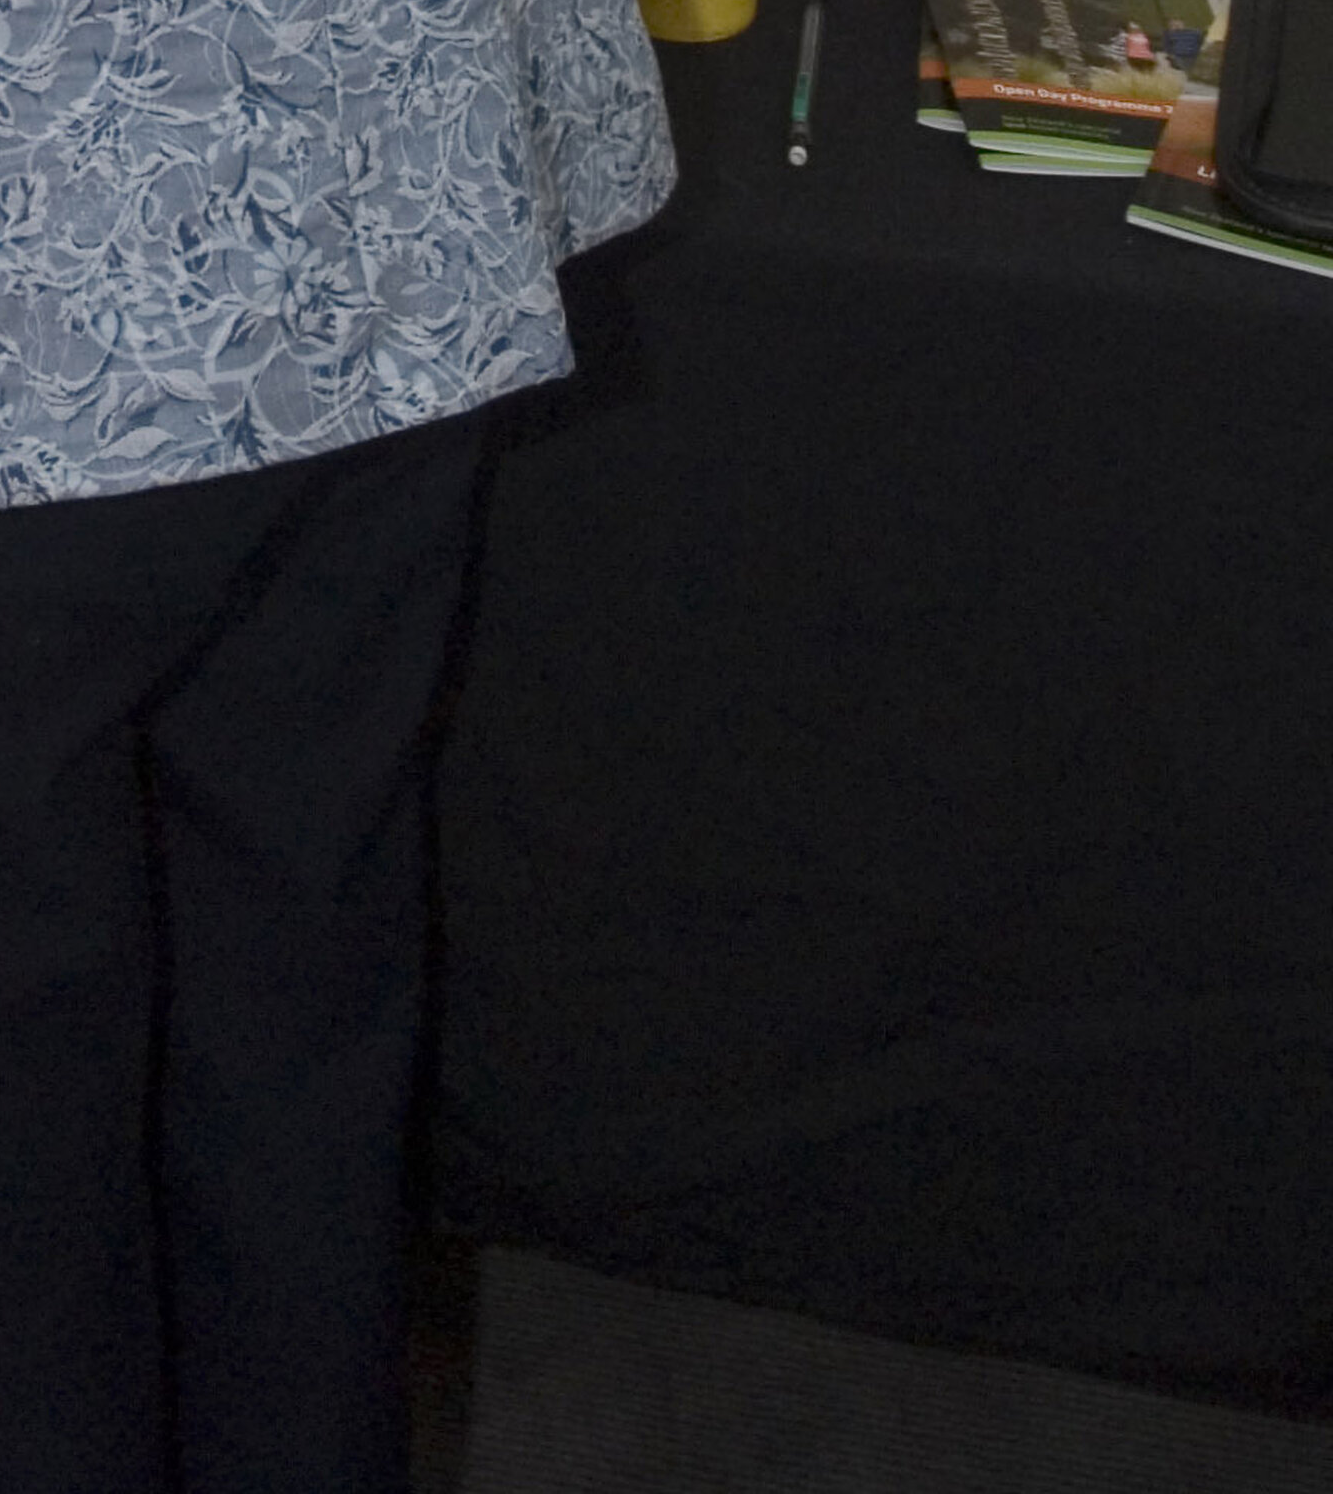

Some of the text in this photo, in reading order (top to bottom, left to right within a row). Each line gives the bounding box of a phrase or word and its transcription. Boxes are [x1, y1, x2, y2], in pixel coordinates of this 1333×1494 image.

[993, 82, 1036, 98] Open
[1037, 87, 1068, 102] Day
[1070, 91, 1162, 113] Programme
